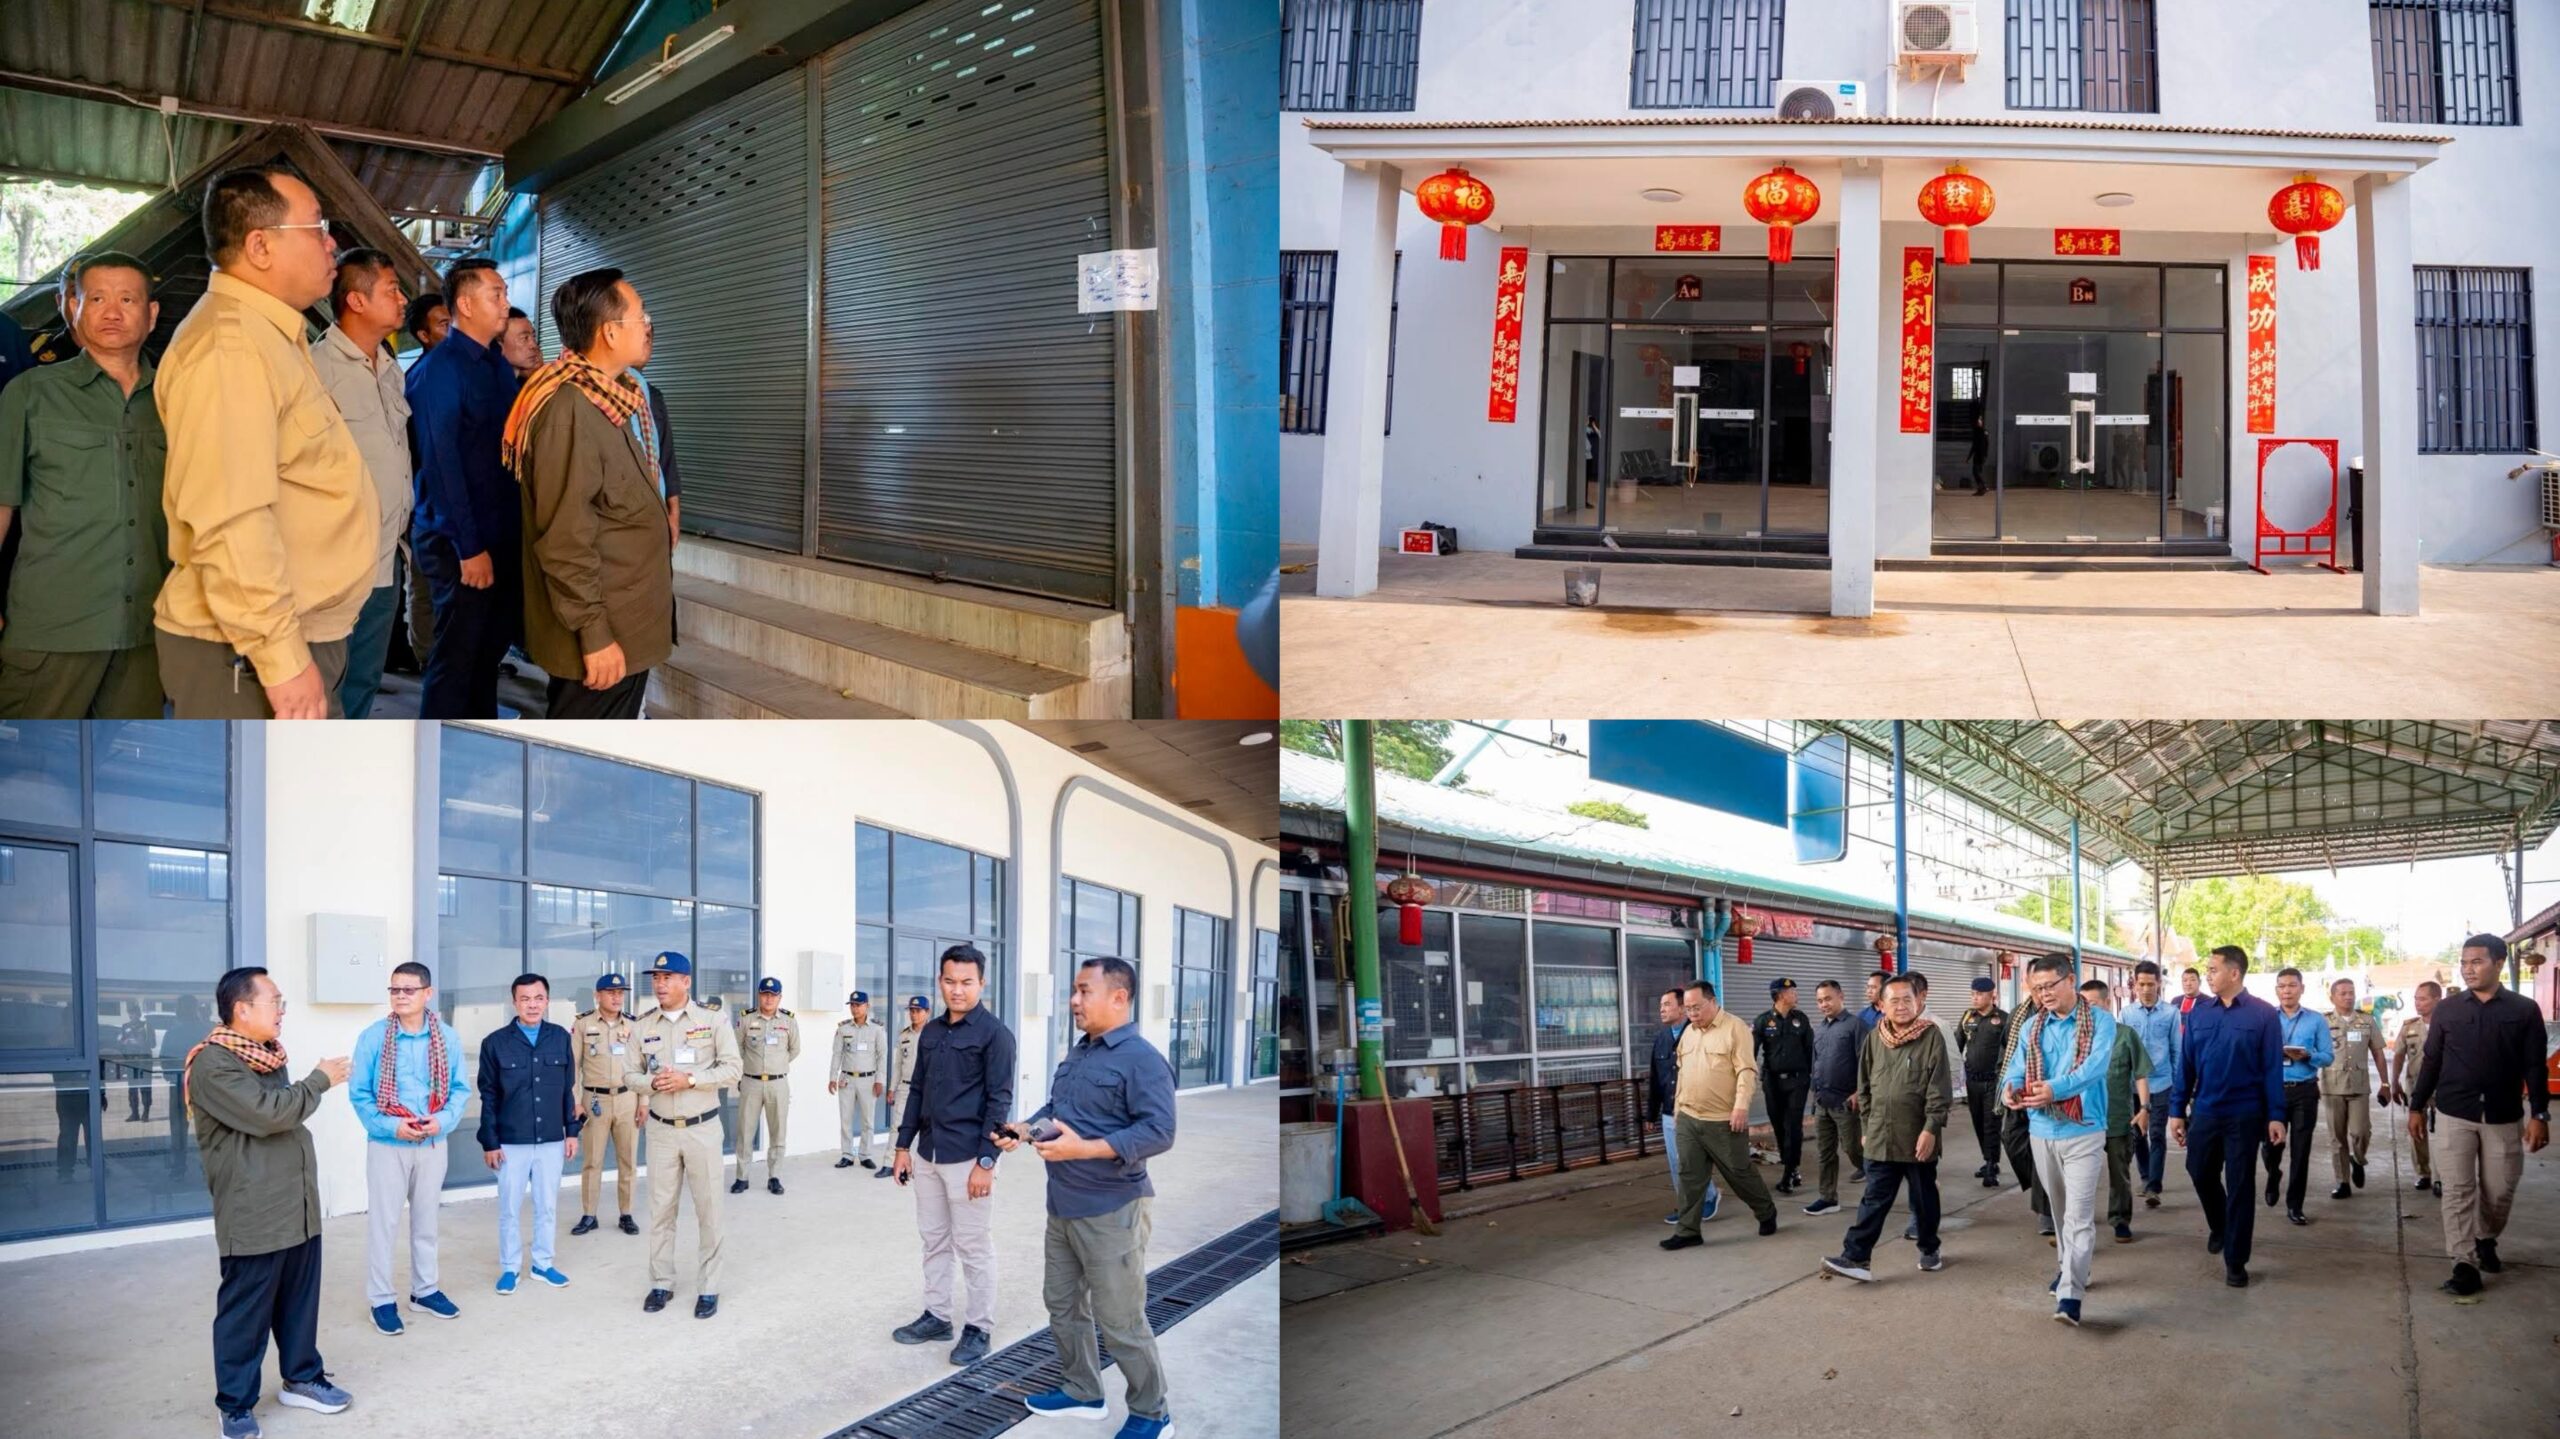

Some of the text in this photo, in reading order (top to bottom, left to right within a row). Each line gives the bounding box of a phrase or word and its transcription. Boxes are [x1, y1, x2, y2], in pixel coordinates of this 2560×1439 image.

[1454, 178, 1486, 210] 福
[1755, 175, 1789, 206] 福
[2249, 266, 2276, 333] 成功
